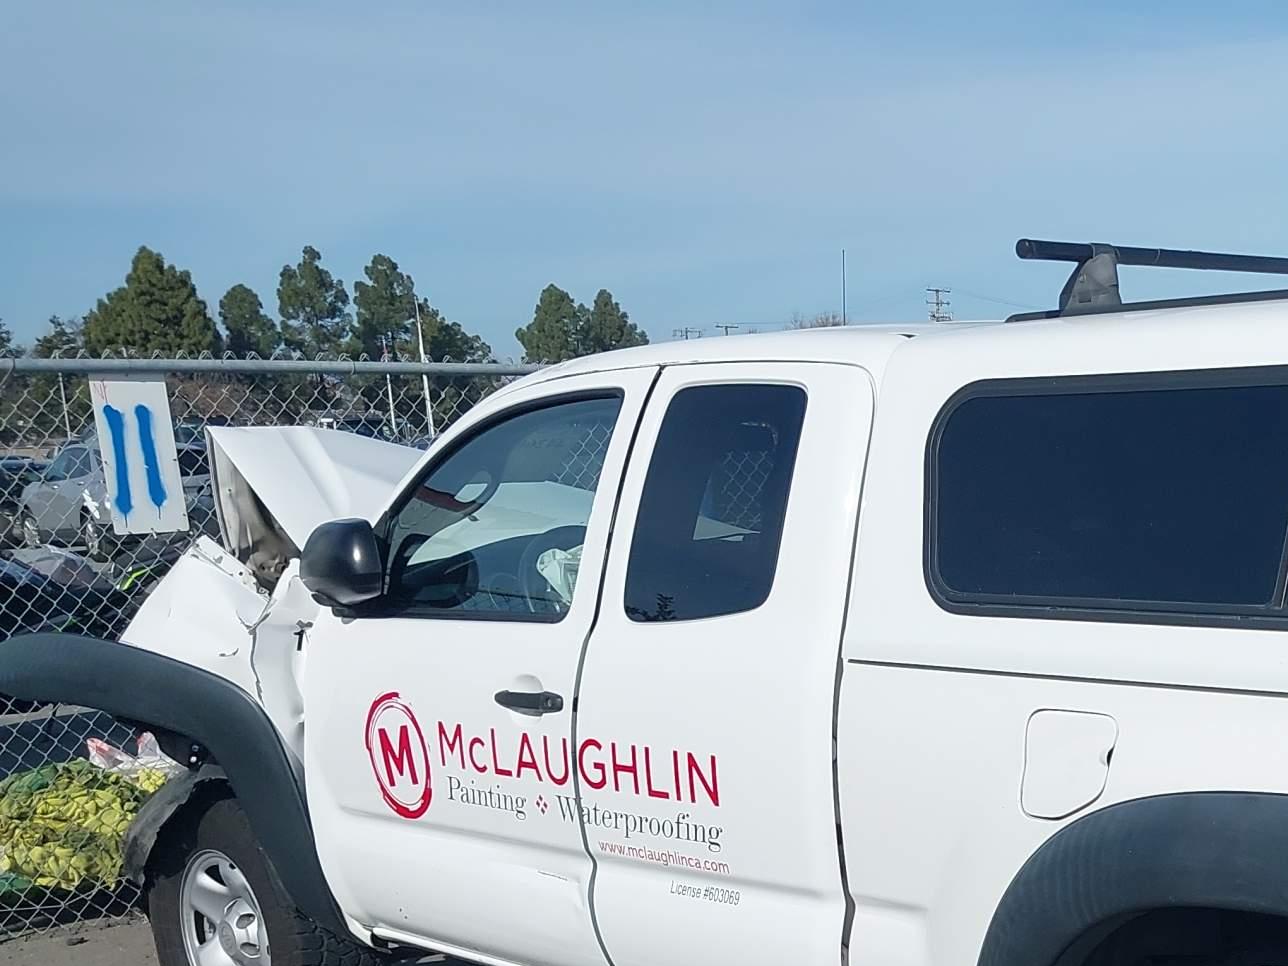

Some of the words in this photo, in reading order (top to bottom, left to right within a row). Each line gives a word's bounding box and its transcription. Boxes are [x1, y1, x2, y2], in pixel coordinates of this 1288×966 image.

[378, 725, 420, 787] M
[437, 720, 721, 807] McLAUGHLIN
[447, 775, 528, 821] Painting
[554, 795, 724, 853] Waterproofing
[599, 841, 729, 875] www.mclaughlinca.com
[670, 880, 702, 899] License
[703, 886, 741, 906] #603069
